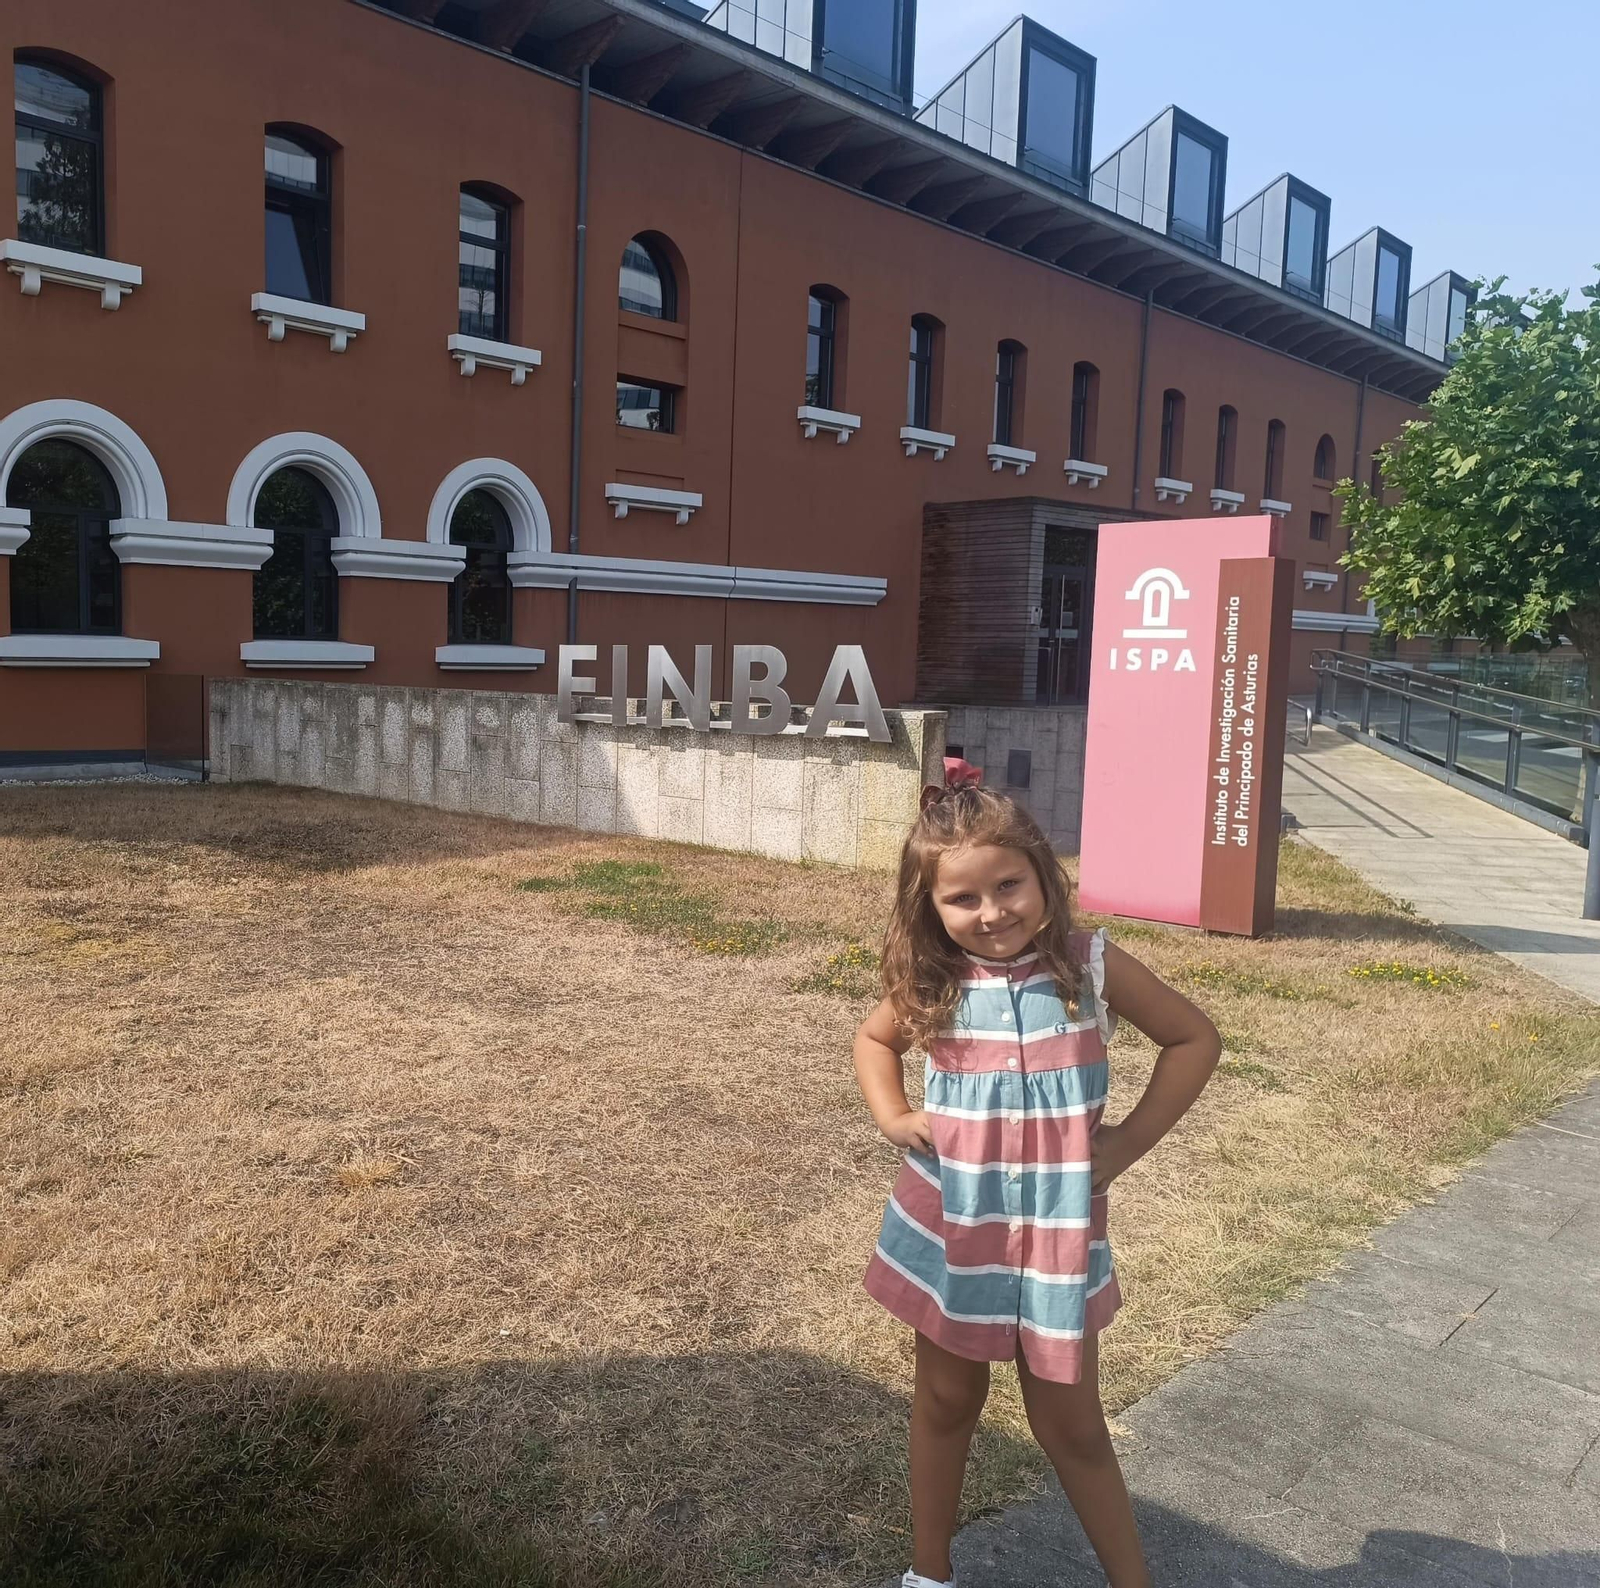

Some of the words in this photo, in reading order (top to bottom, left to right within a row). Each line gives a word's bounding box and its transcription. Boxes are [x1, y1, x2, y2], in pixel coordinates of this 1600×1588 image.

[1221, 596, 1240, 663] Sanitaria
[1109, 648, 1196, 672] ISPA
[1240, 654, 1258, 714] Asturias
[557, 644, 893, 743] FINBA
[1215, 668, 1237, 762] Investigación
[1237, 718, 1254, 736] de
[1213, 767, 1230, 785] de
[1234, 741, 1255, 819] Principado
[1211, 790, 1228, 845] Instituto
[1231, 824, 1248, 847] del
